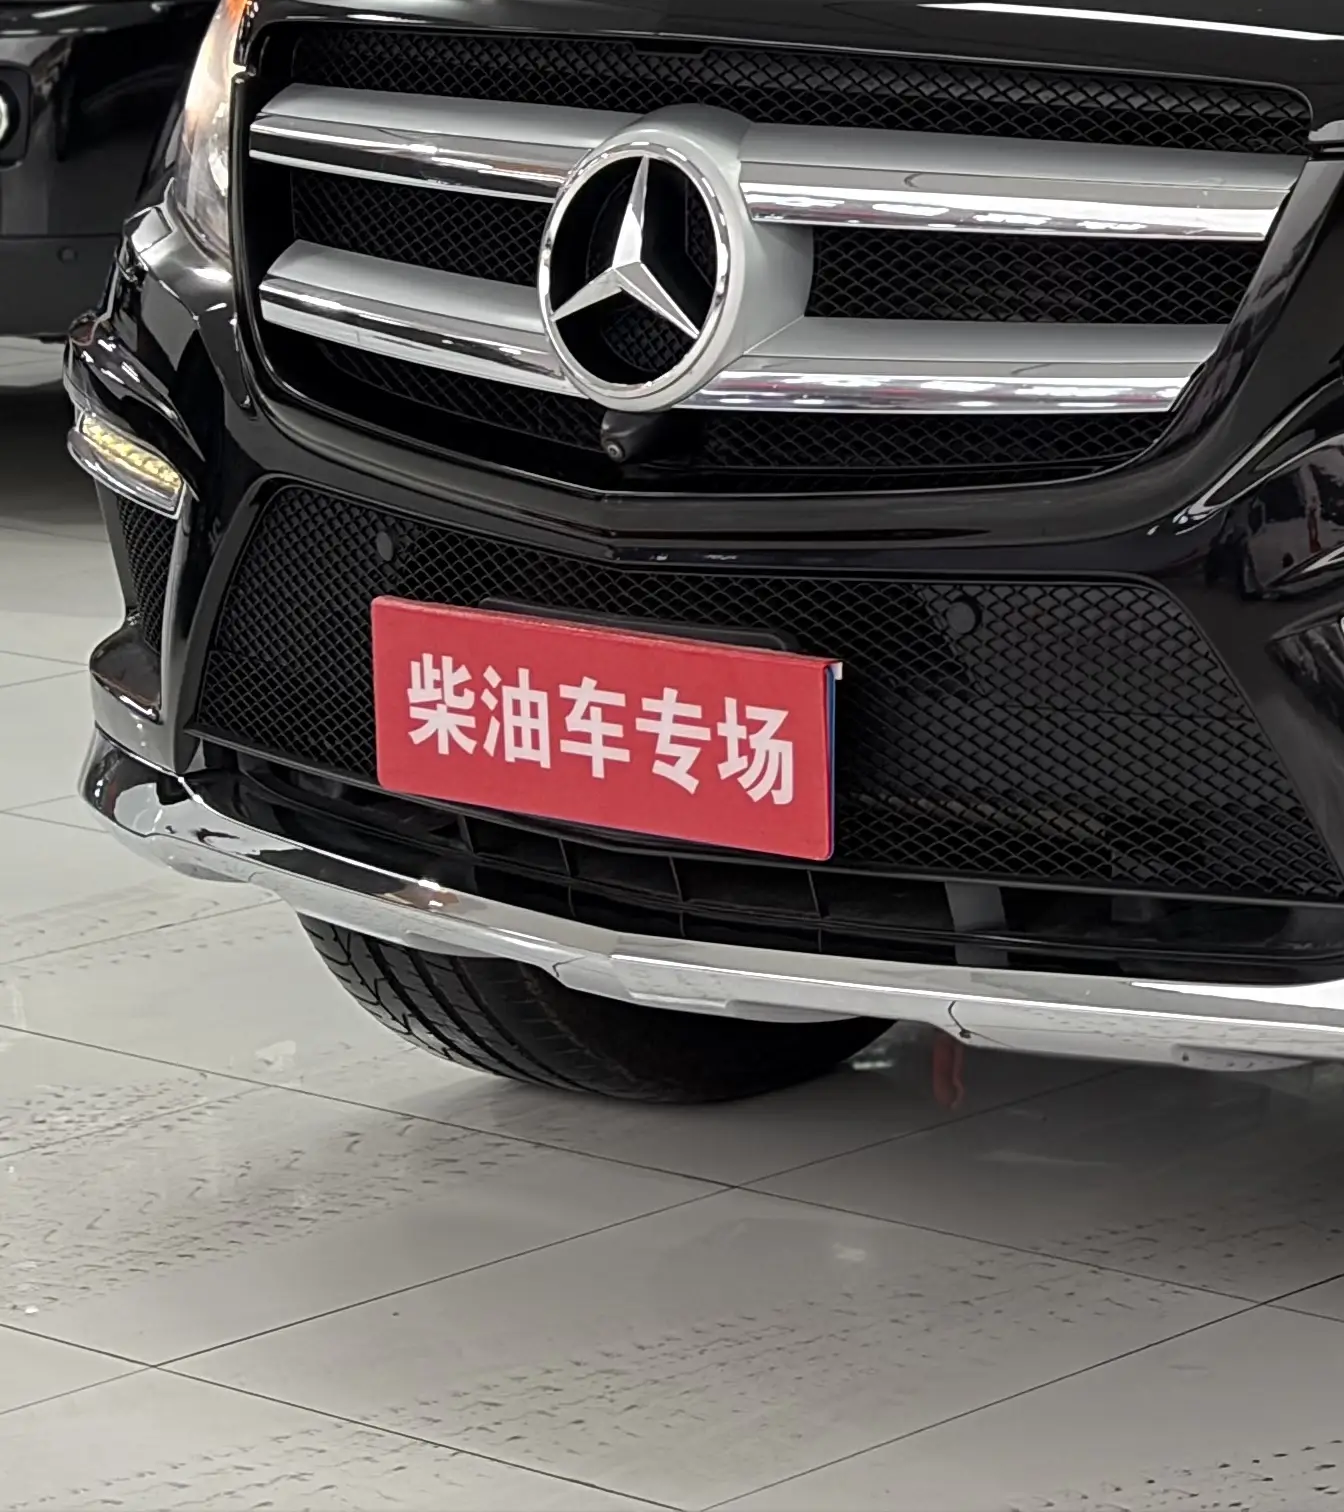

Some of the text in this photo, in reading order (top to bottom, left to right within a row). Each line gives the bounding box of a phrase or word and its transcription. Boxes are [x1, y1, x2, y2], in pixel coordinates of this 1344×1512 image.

[407, 653, 794, 805] 柴油车专场
